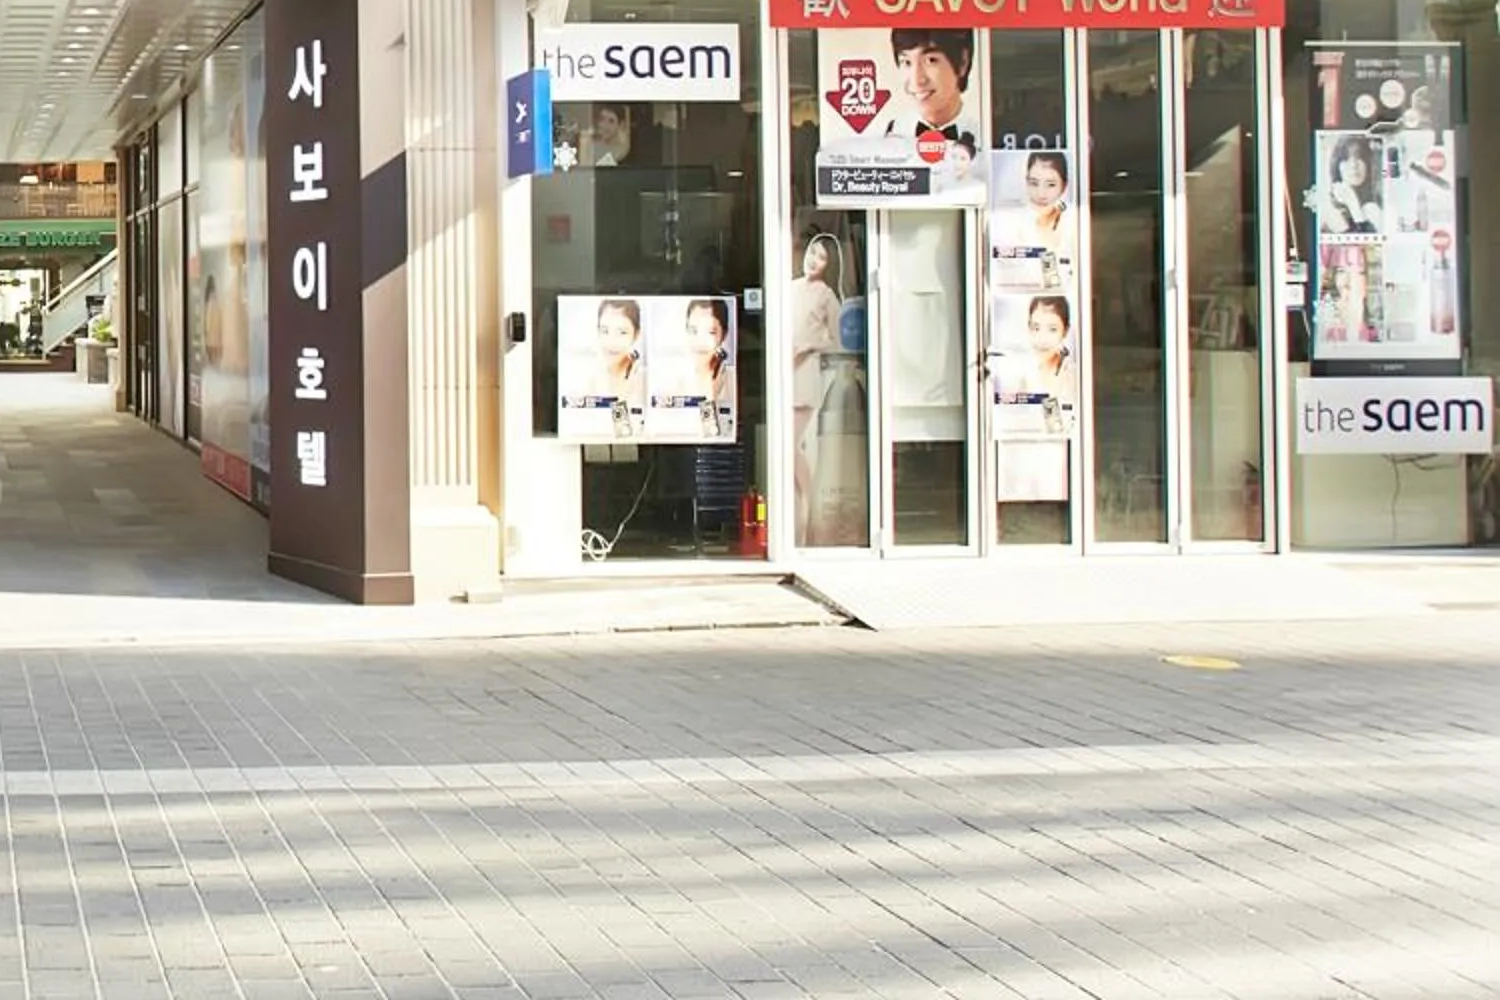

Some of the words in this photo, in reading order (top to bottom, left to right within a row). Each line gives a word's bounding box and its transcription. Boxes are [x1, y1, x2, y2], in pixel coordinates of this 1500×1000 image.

[603, 42, 732, 80] saem
[841, 77, 877, 105] 20
[841, 104, 877, 116] DOWN
[287, 39, 329, 488] 사보이호텔
[1303, 400, 1355, 433] the
[1362, 398, 1484, 433] saem
